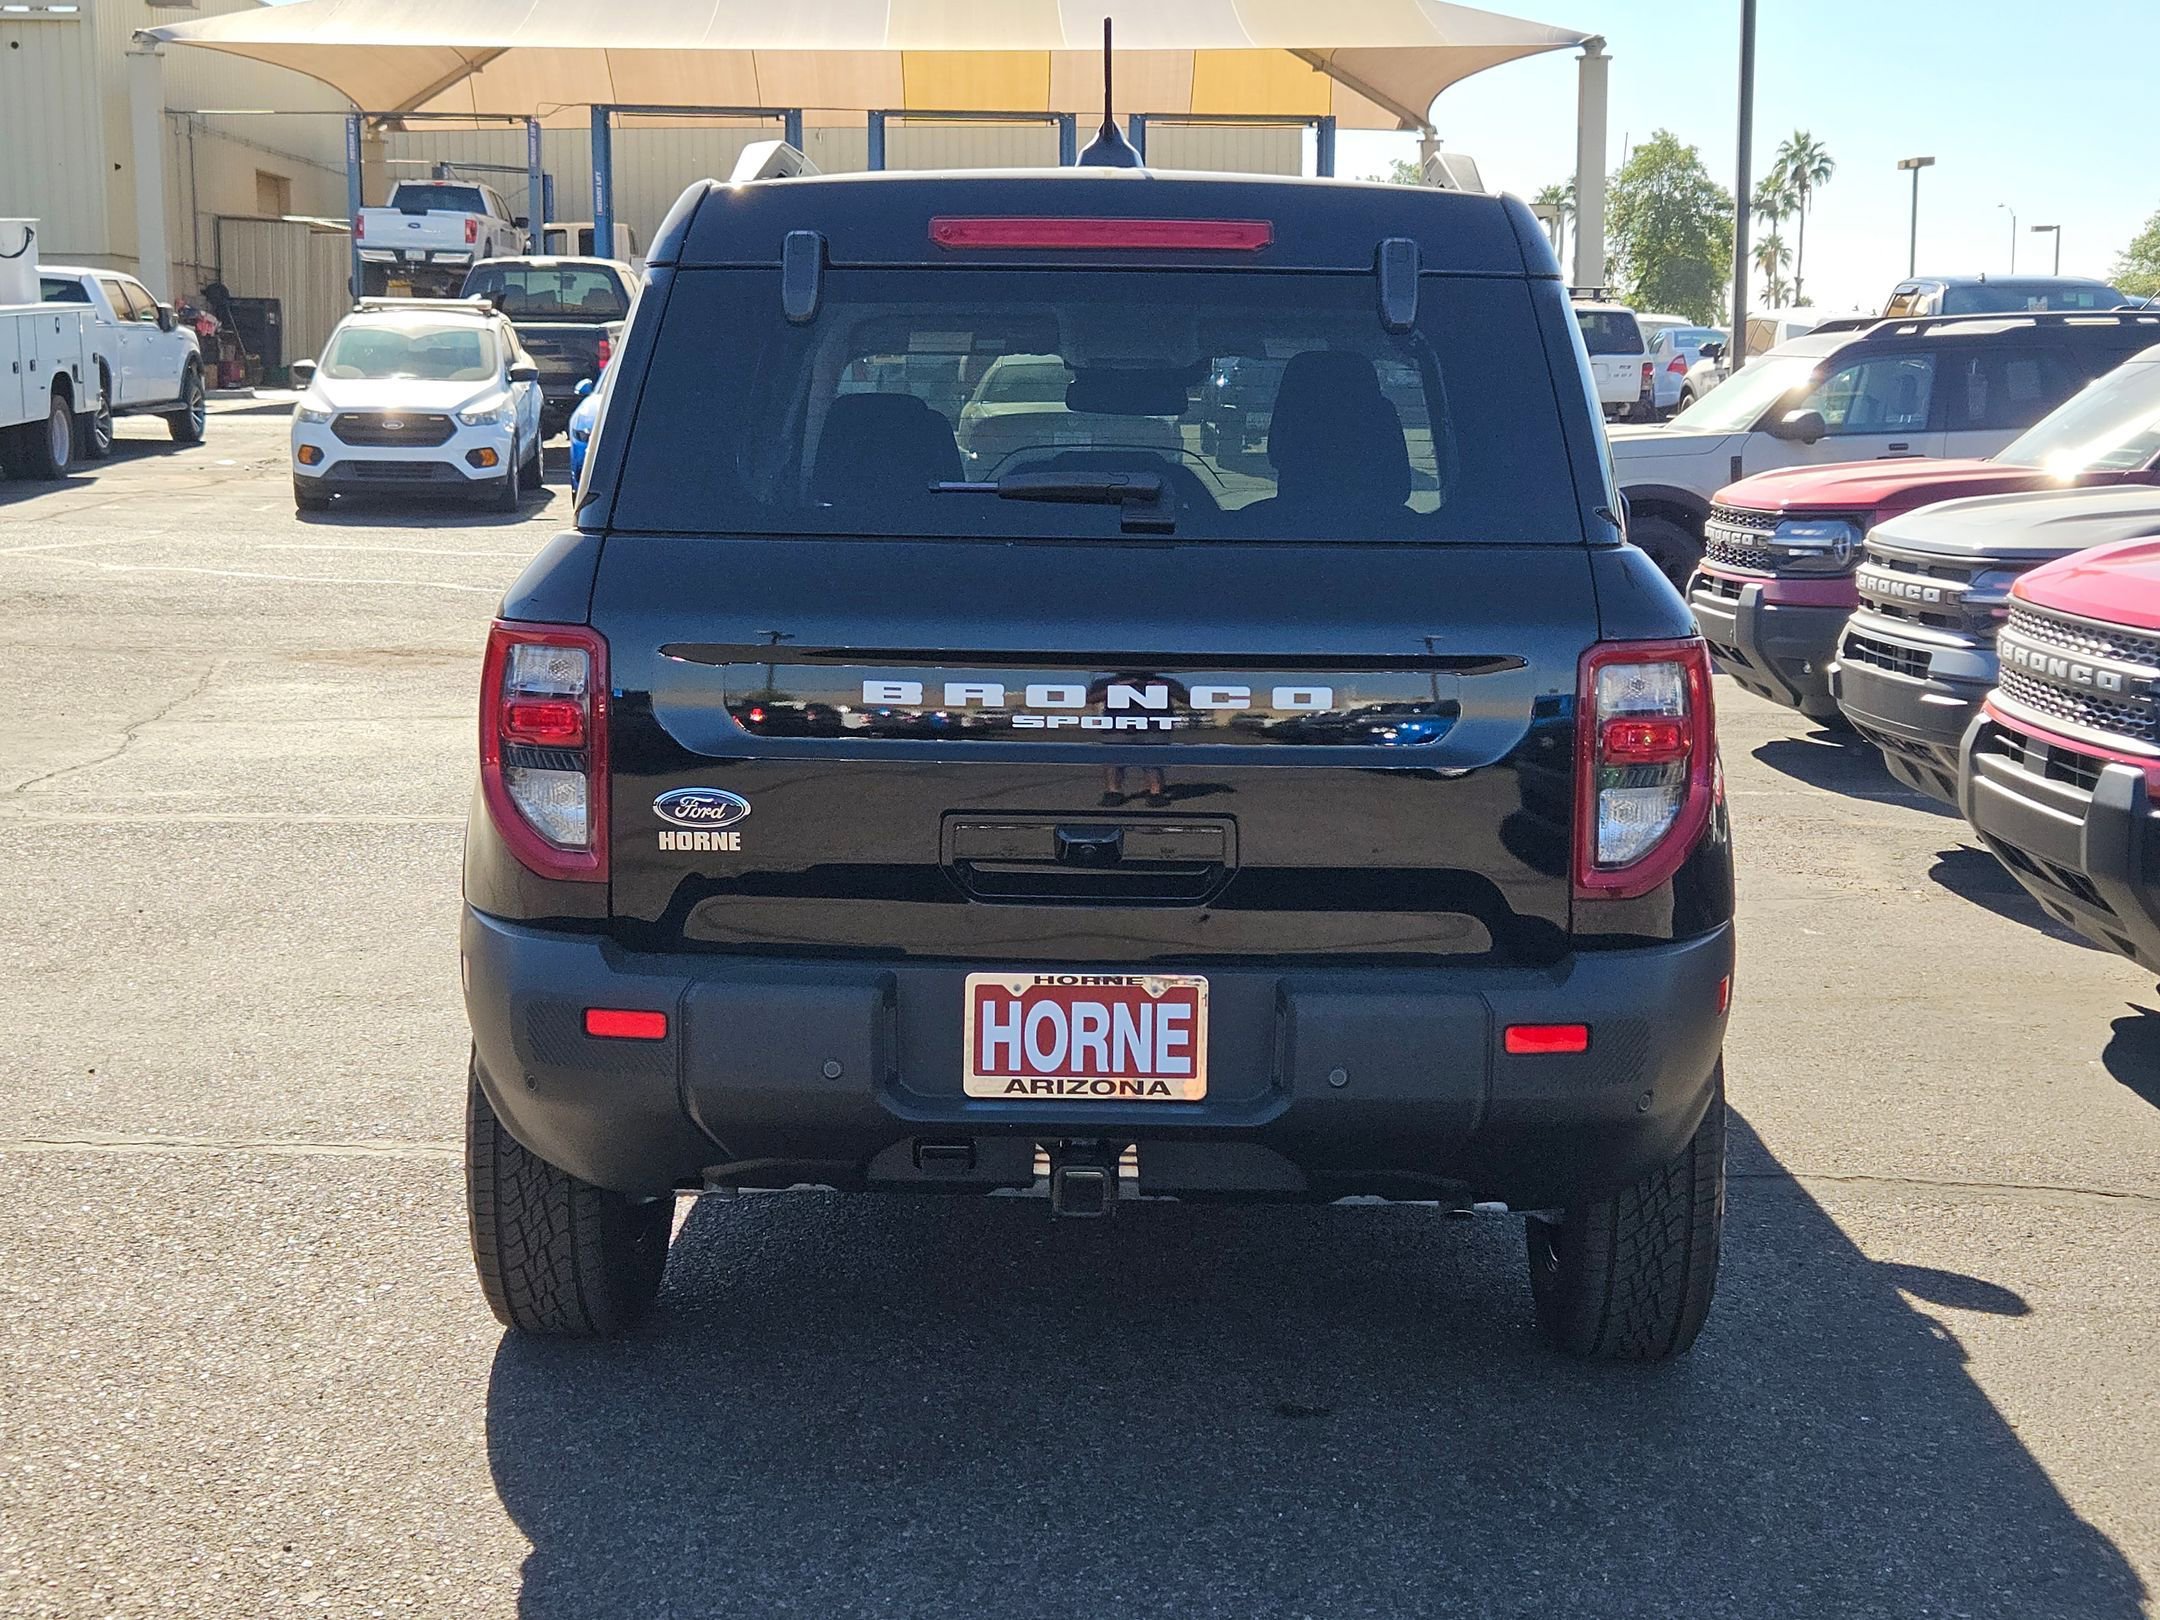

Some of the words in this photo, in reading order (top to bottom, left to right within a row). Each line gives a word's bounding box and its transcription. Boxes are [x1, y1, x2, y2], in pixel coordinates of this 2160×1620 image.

[1858, 573, 1941, 603] BRONCO
[2001, 640, 2123, 692] BRONCO
[861, 679, 1334, 711] BRONCO
[1011, 714, 1178, 731] SPORT
[674, 795, 727, 820] Ford
[658, 831, 741, 852] HORNE
[1033, 975, 1144, 986] HORNE
[981, 999, 1192, 1074] HORNE
[1003, 1078, 1173, 1097] ARIZONA
